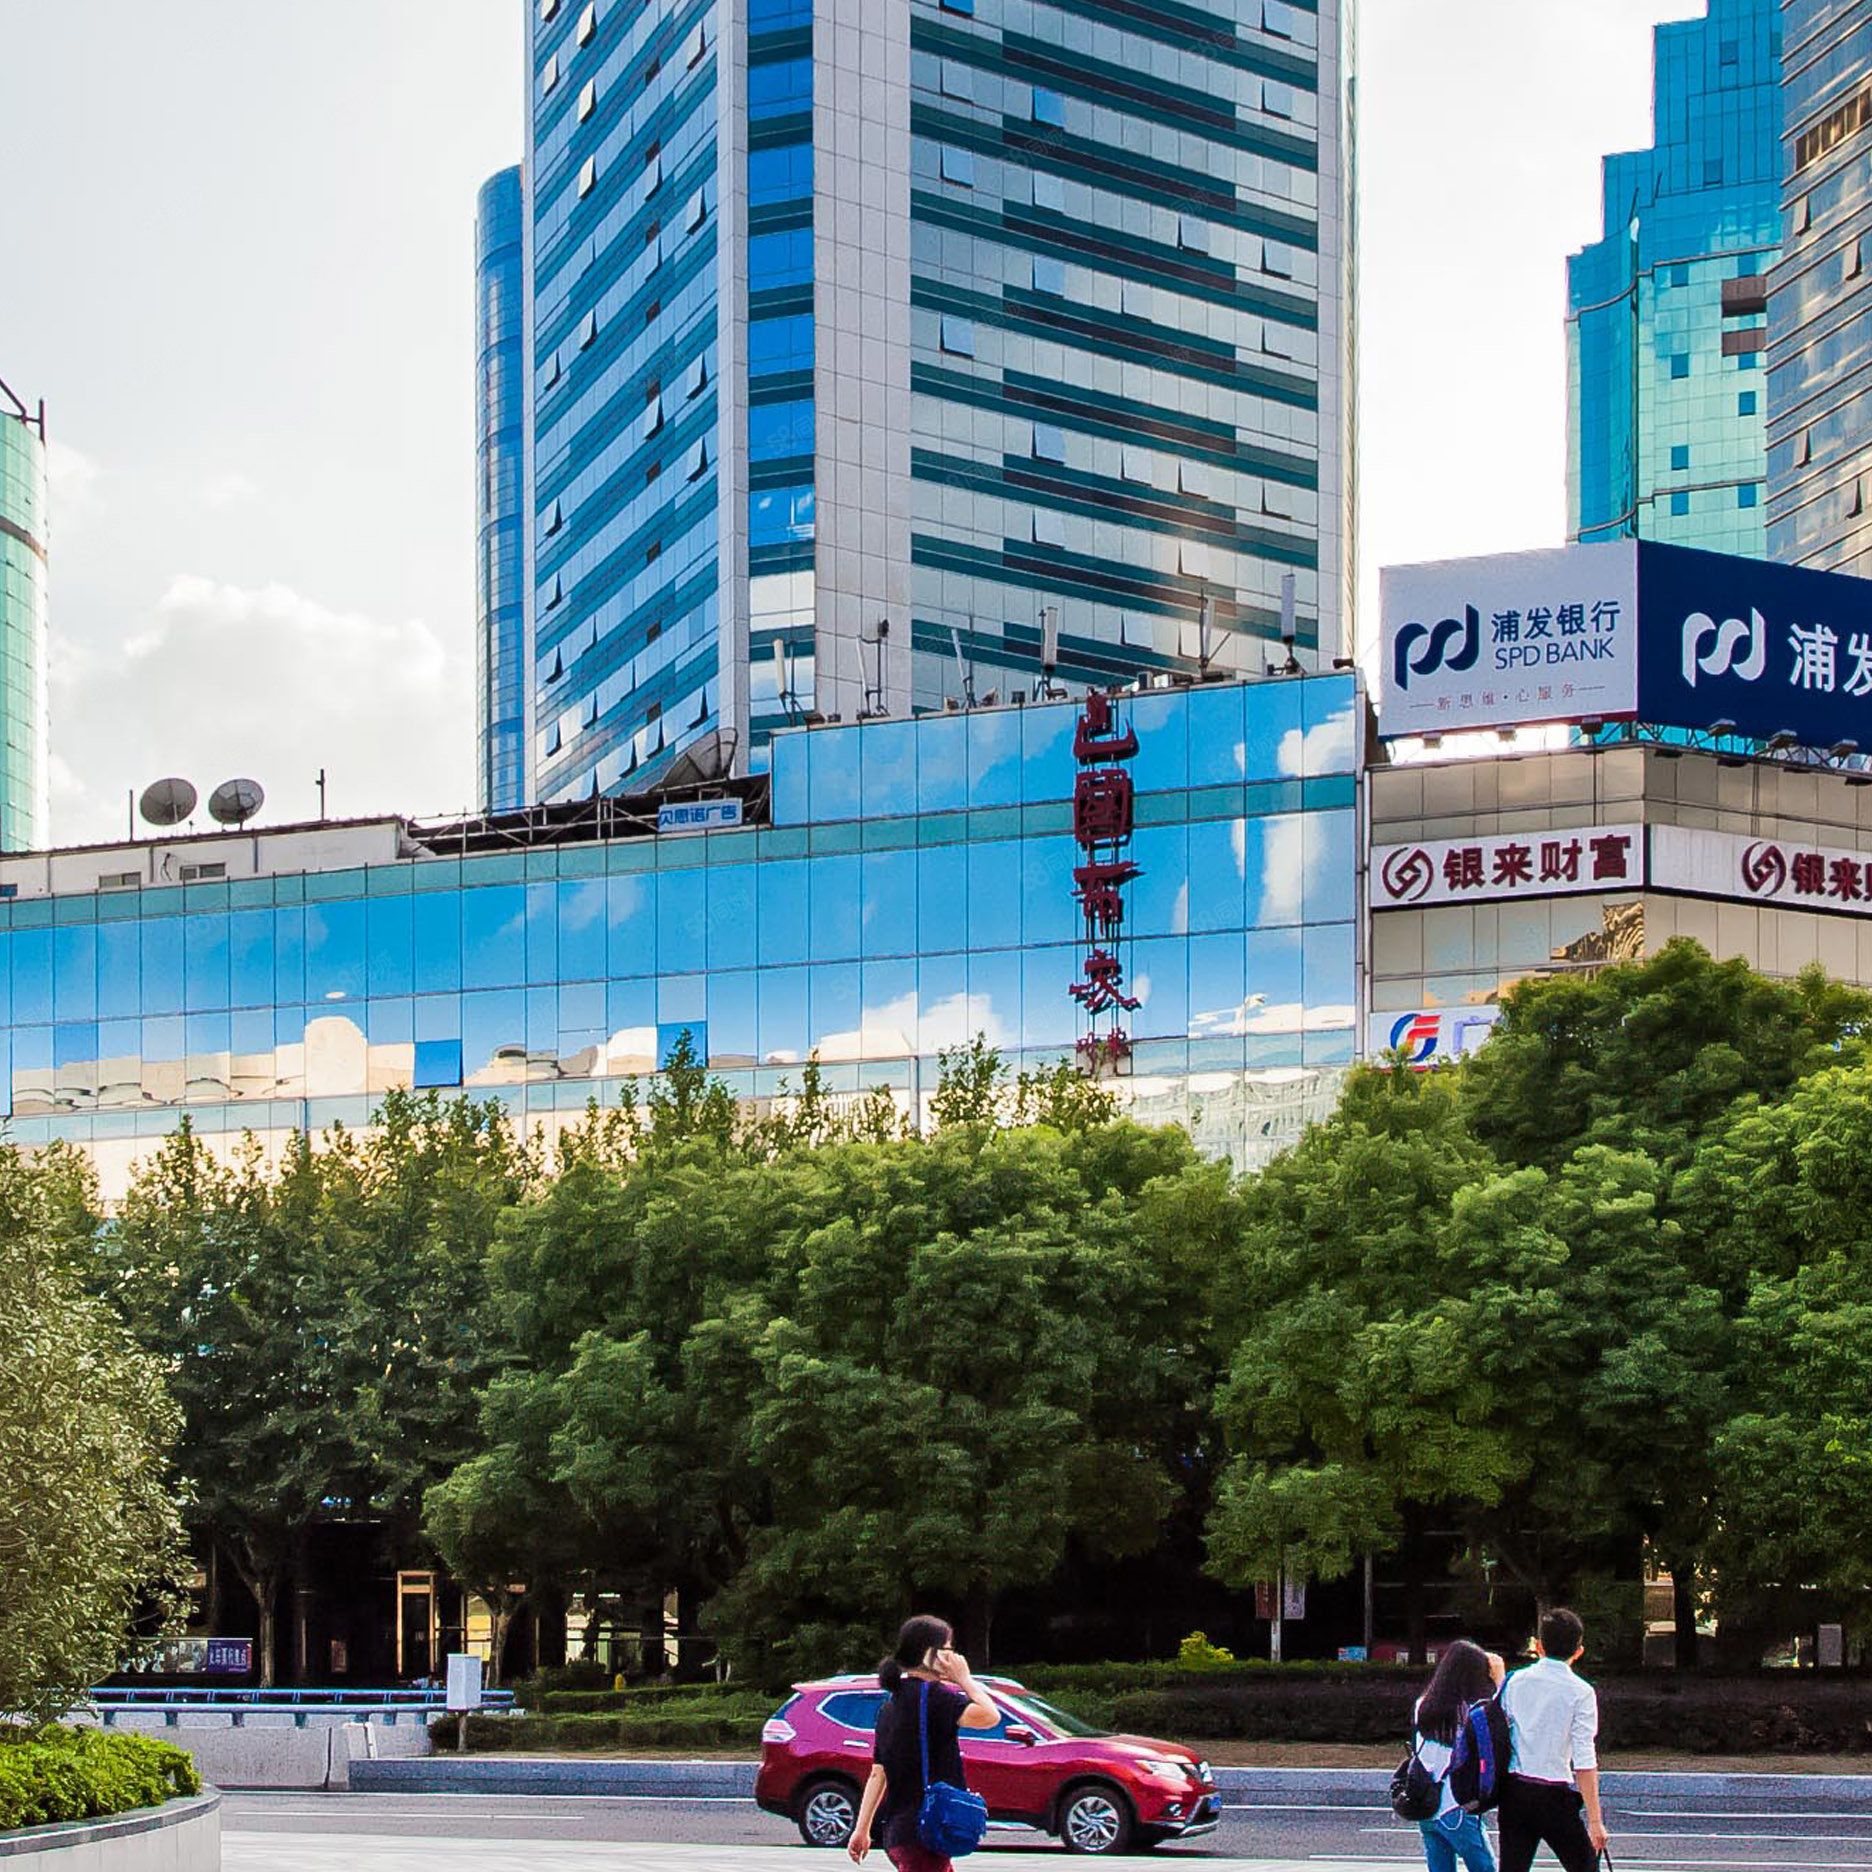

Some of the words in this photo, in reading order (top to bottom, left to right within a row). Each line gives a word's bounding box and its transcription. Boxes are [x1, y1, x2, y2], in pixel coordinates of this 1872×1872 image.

[1491, 601, 1620, 643] 浦发银行
[1495, 645, 1540, 670] SPD
[1546, 637, 1615, 665] BANK
[1443, 835, 1631, 891] 银来财富
